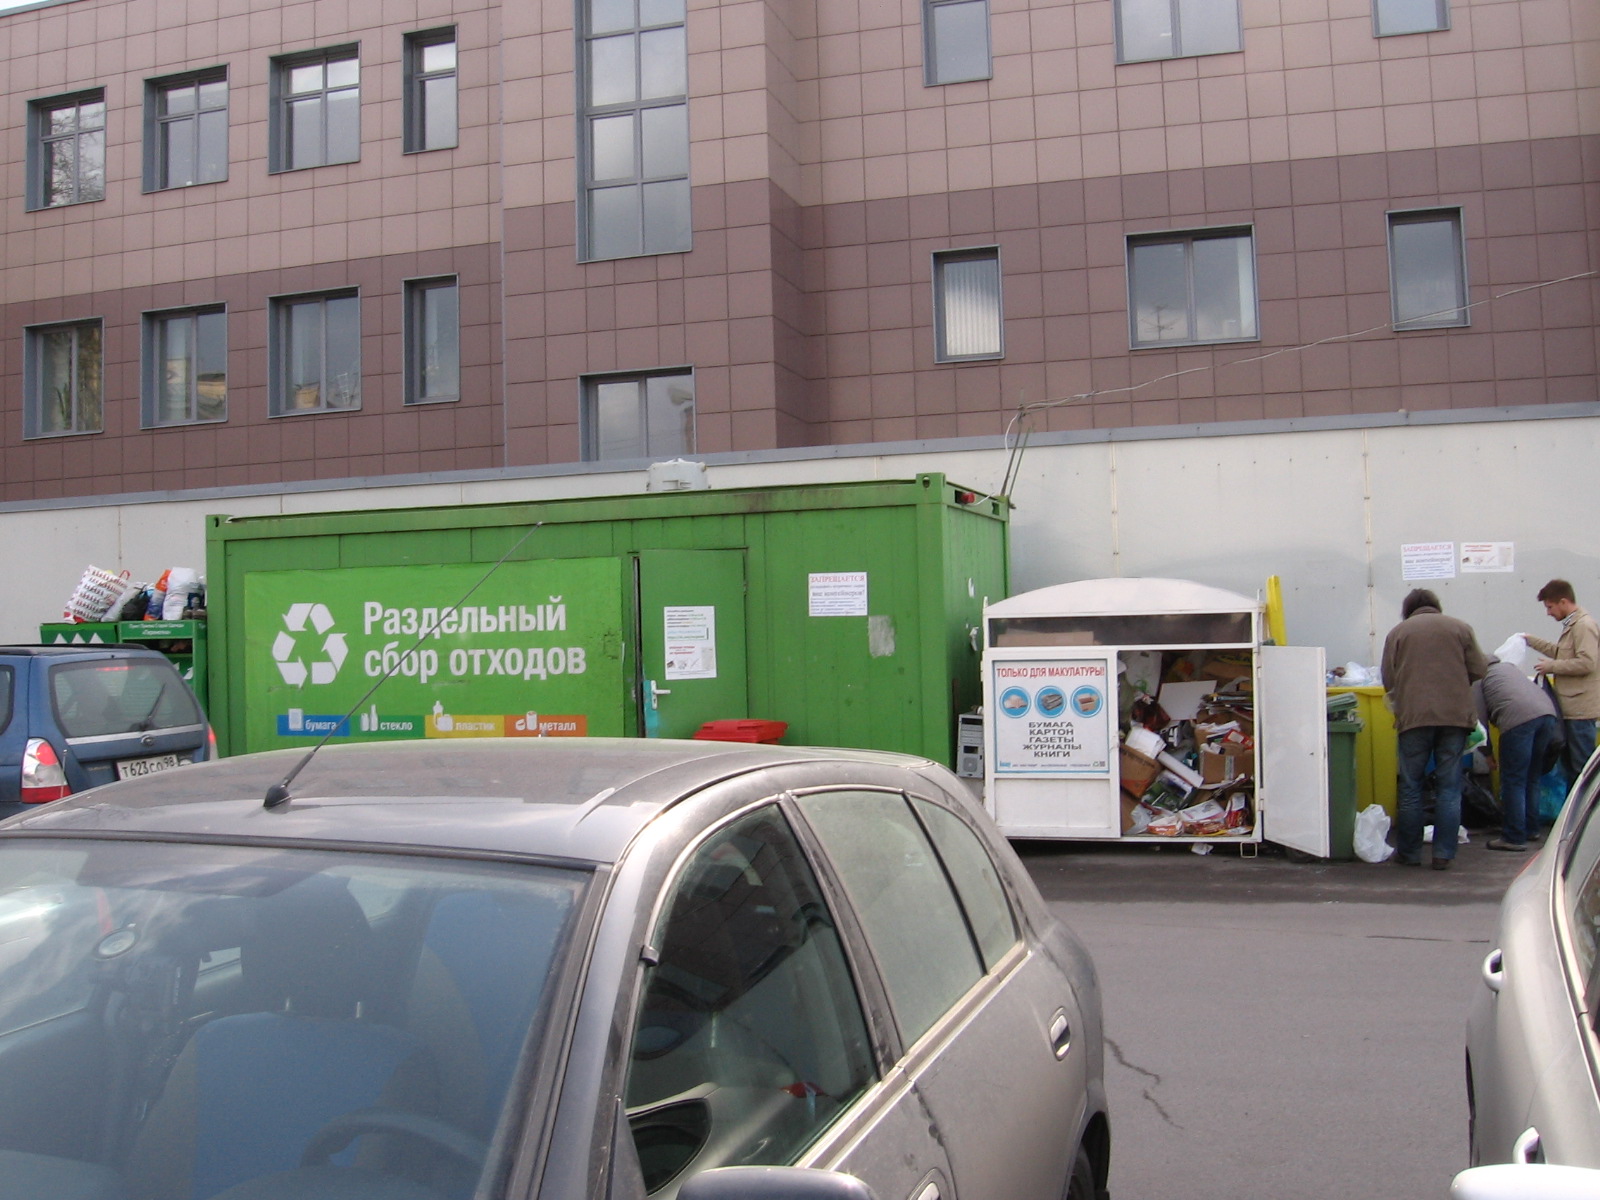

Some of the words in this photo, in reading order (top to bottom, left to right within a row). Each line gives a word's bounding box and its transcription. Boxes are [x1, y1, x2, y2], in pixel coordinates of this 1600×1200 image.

[810, 575, 865, 583] ЗАПРЕЩАЕТСЯ
[364, 595, 567, 639] Раздельный
[364, 641, 438, 684] сбор
[449, 647, 586, 681] отходов
[996, 668, 1028, 678] ТОЛЬКО
[1029, 667, 1047, 679] ДЛЯ
[305, 719, 337, 732] бумага
[380, 720, 413, 731] стекло
[455, 721, 495, 732] пластик
[538, 721, 577, 732] металл
